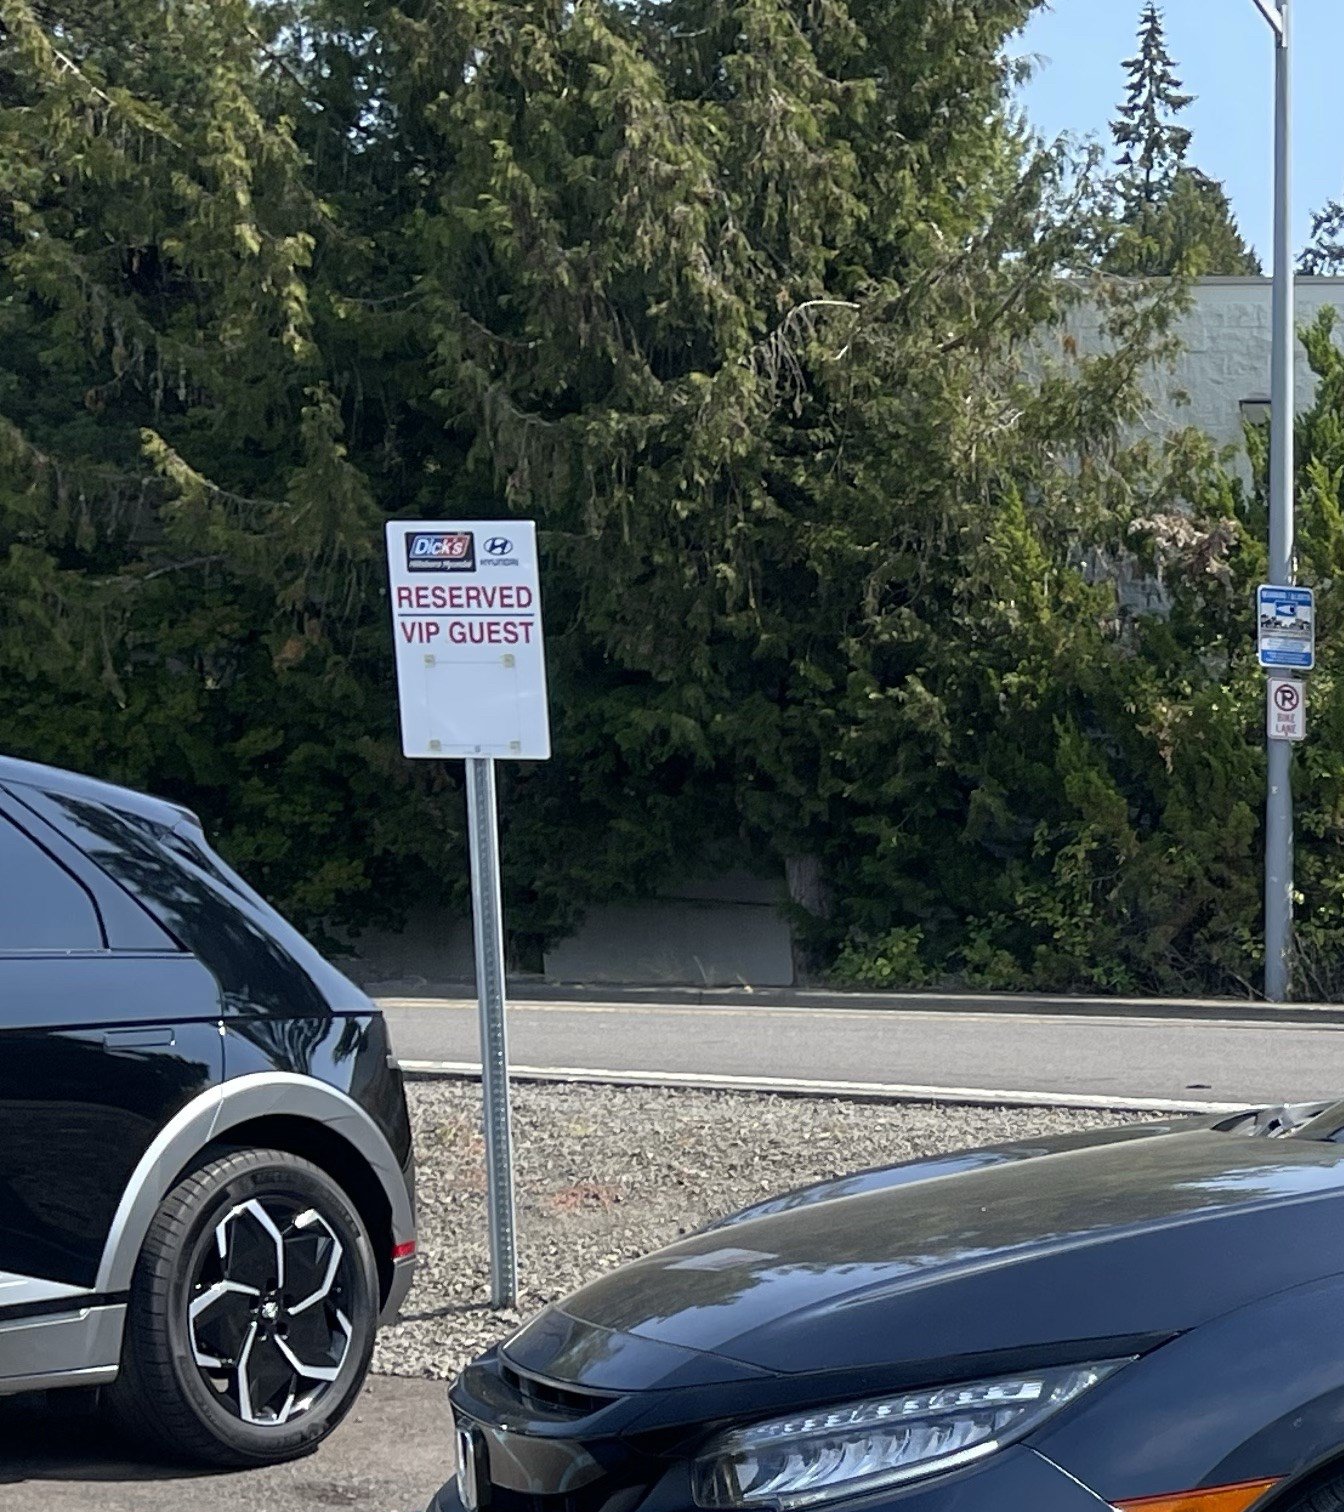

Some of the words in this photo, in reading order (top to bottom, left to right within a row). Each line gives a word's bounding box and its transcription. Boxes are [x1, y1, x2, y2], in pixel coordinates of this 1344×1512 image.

[396, 585, 533, 609] RESERVED
[400, 621, 441, 644] VIP
[448, 620, 534, 645] GUEST
